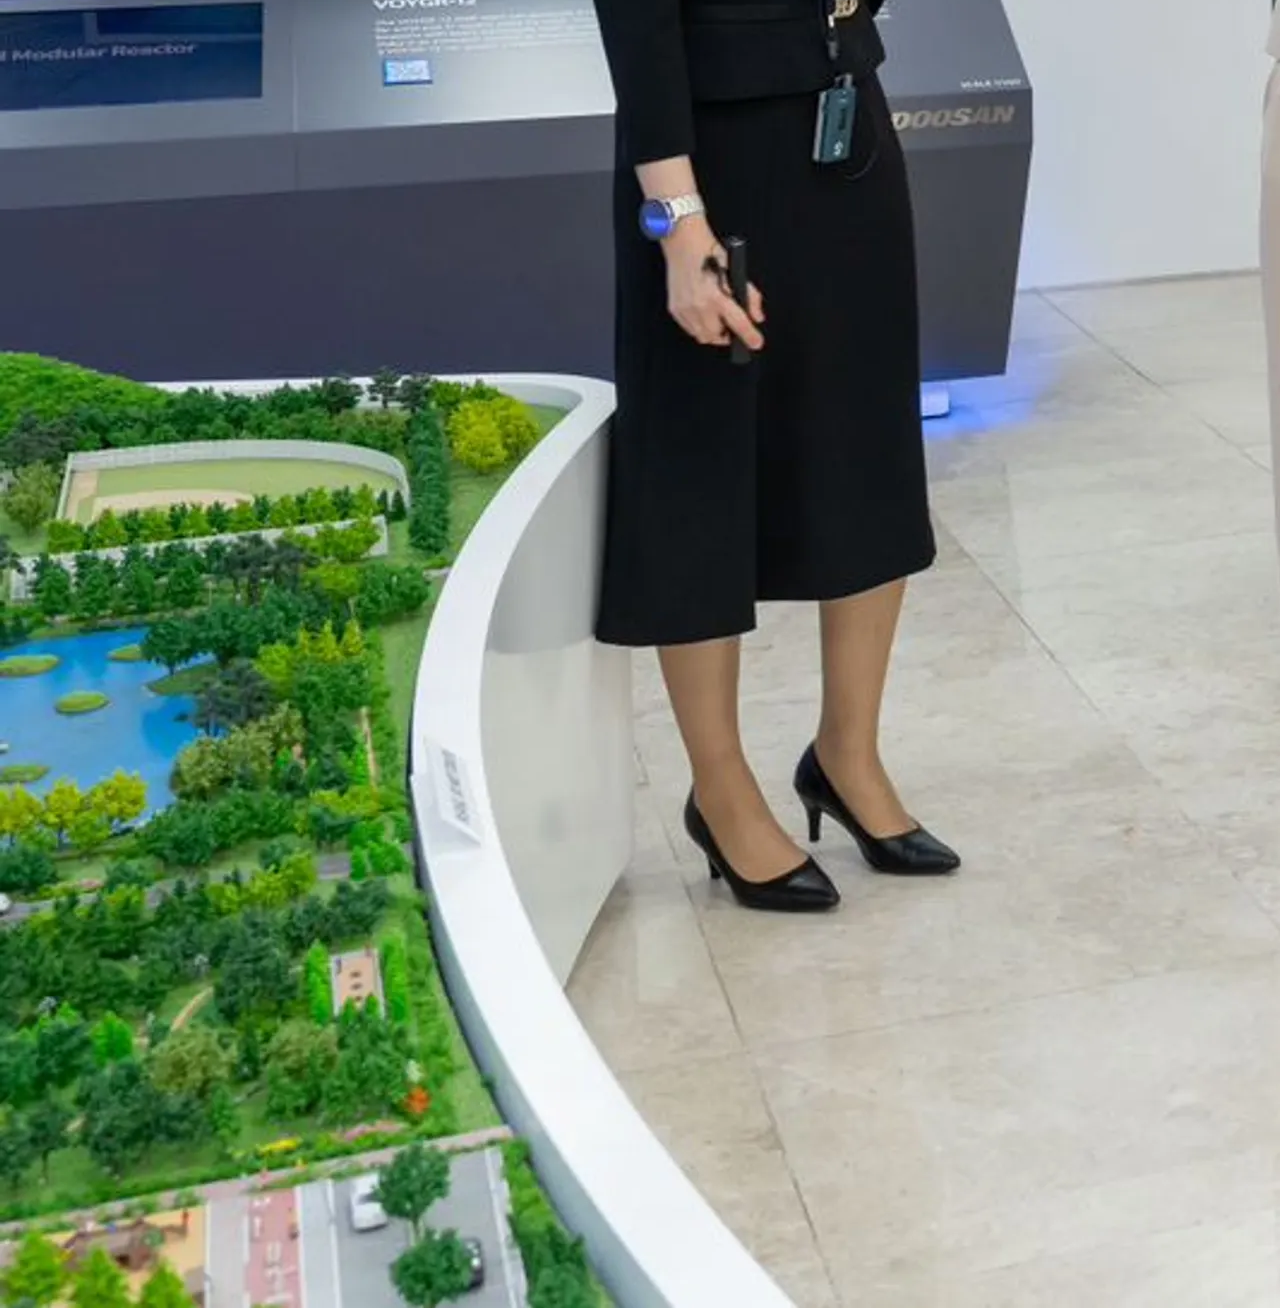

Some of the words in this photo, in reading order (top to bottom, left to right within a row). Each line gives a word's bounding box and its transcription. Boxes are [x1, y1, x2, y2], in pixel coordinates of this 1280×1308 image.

[12, 46, 107, 63] Modular
[111, 42, 196, 57] Reactor
[890, 105, 1015, 131] DOOSAN
